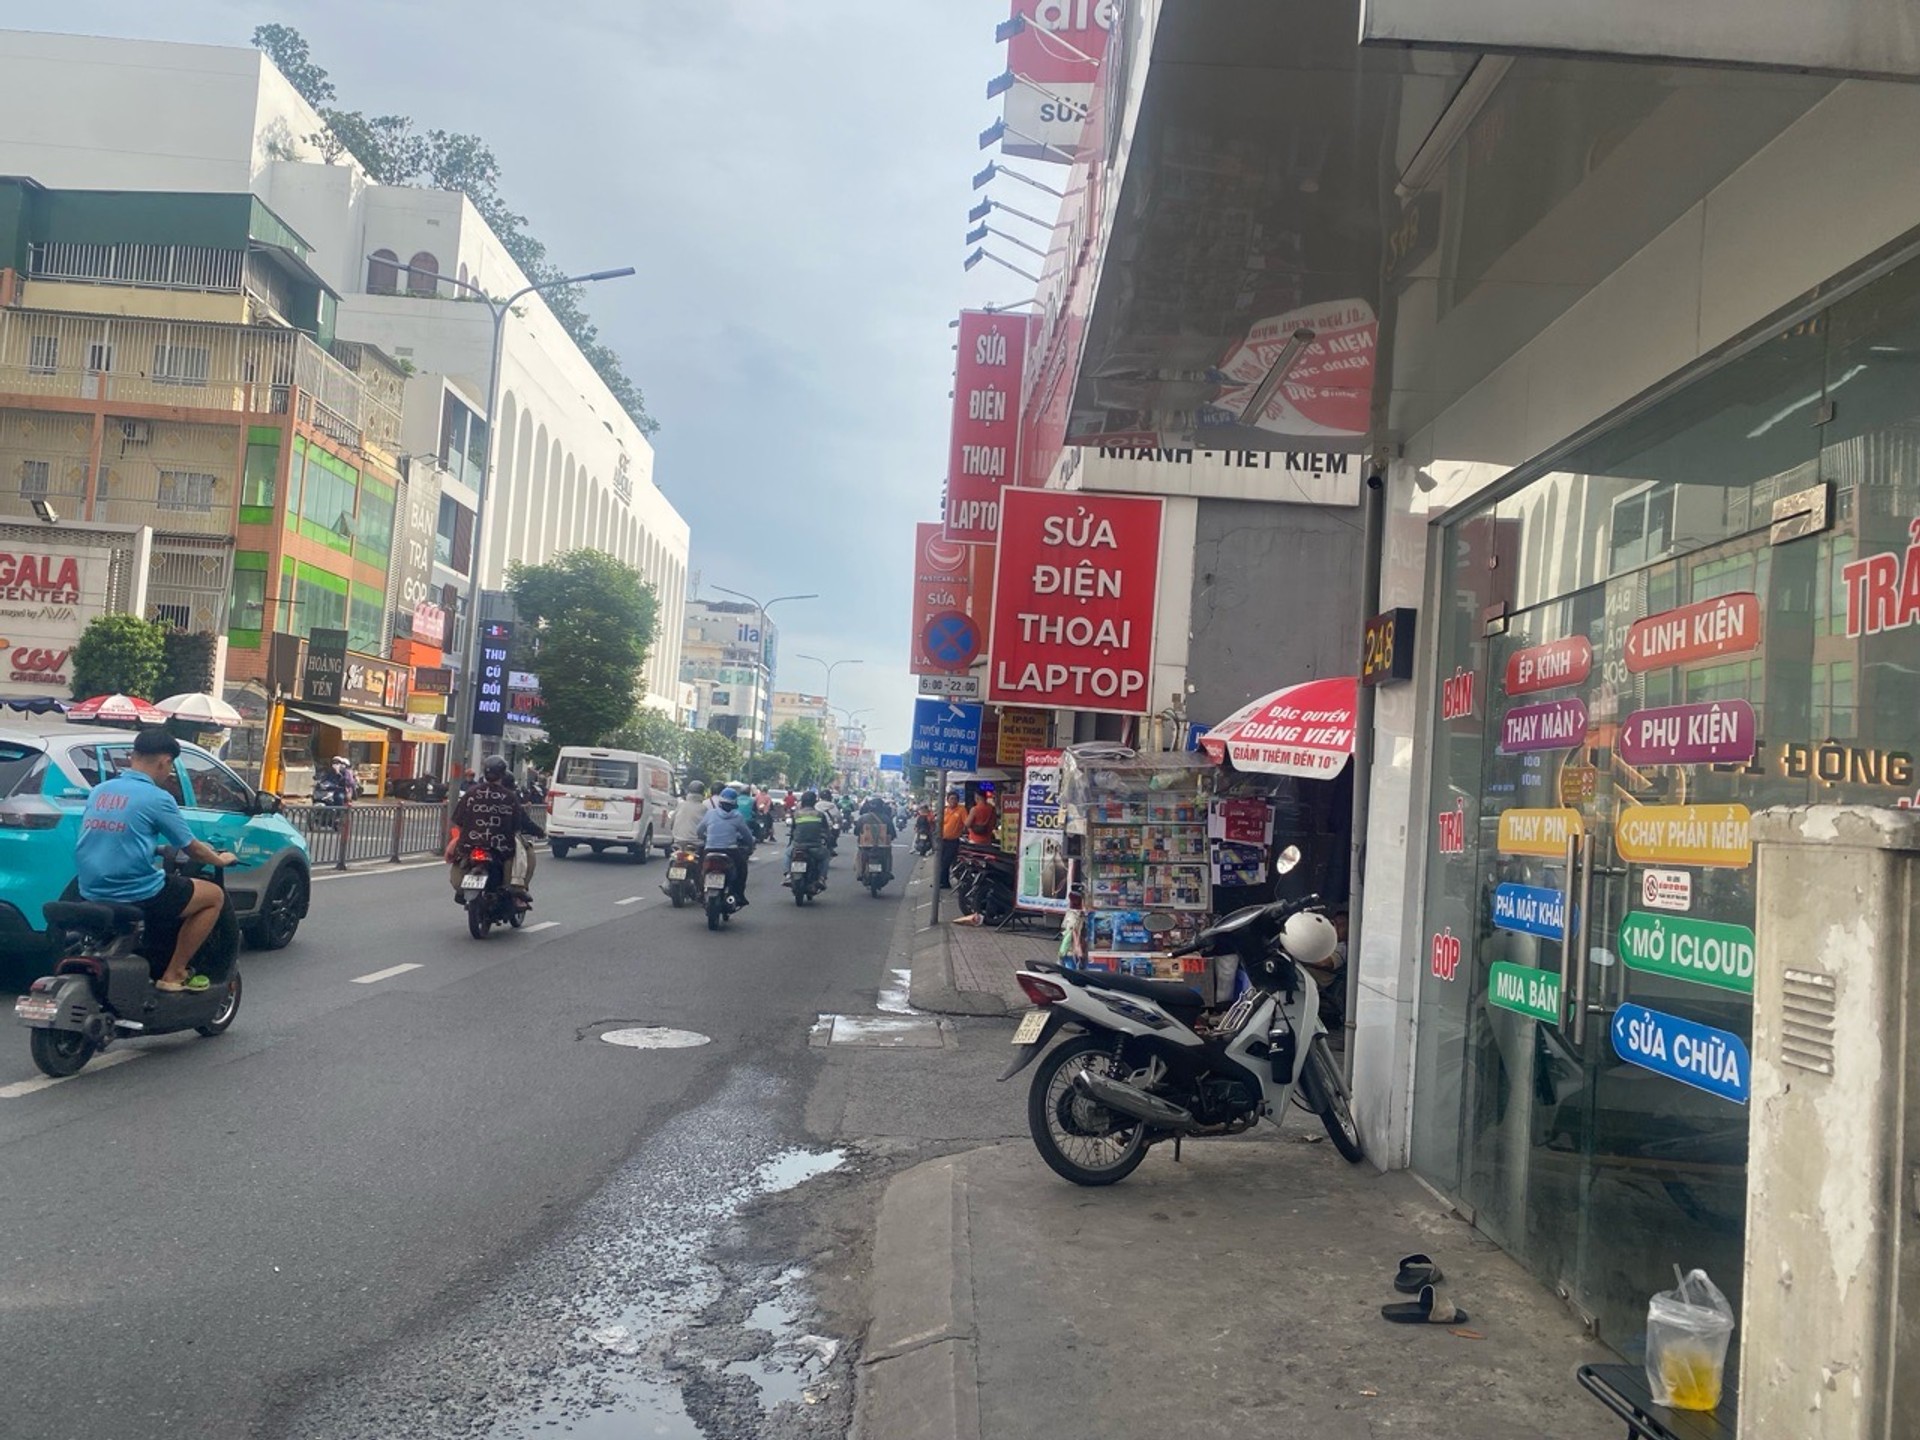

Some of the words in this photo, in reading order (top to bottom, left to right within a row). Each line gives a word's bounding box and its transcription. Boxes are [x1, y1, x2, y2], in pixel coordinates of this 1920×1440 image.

[976, 324, 1006, 366] SỬA
[969, 384, 1005, 427] ĐIỆN
[962, 444, 1005, 483] THOẠI
[950, 500, 998, 532] LAPTO
[1042, 506, 1118, 549] SỬA
[0, 586, 79, 605] ENTER
[927, 588, 957, 606] SỬA
[1032, 559, 1122, 604] ĐIỆN
[1842, 516, 1920, 638] TRẢ
[738, 623, 760, 643] ila
[1017, 613, 1132, 656] THOẠI
[1364, 620, 1394, 676] 248
[1643, 619, 1687, 657] LINH
[1694, 600, 1745, 650] KIỆN
[11, 647, 69, 673] CGV
[484, 648, 507, 661] THU
[1518, 654, 1534, 684] ÉP
[1537, 648, 1571, 680] KÍNH
[998, 660, 1144, 698] LAPTOP
[1442, 665, 1474, 721] BÁN
[1241, 719, 1302, 742] GIẢNG
[1303, 726, 1351, 746] VIÊN
[1268, 705, 1301, 721] ĐẶC
[1507, 714, 1538, 743] THAY
[1541, 703, 1574, 740] MÀN
[1641, 716, 1681, 756] PHỤ
[1688, 703, 1738, 754] KIỆN
[1233, 744, 1260, 761] GIẢM
[1262, 747, 1291, 764] THÊM
[1293, 749, 1316, 767] ĐẾN
[1781, 736, 1914, 788] ĐỘNG
[1438, 796, 1464, 853] TRẢ
[1509, 816, 1540, 842] THAY
[1544, 816, 1567, 842] PIN
[1629, 821, 1665, 854] CHẠY
[1496, 891, 1514, 917] PHÁ
[1517, 894, 1537, 928] MẬT
[1432, 926, 1460, 981] GÓP
[1633, 919, 1665, 961] MỞ
[1671, 932, 1754, 978] ICLOUD
[1497, 971, 1525, 1003] MUA
[1529, 974, 1558, 1013] BÁN
[1628, 1012, 1667, 1061] SỬA
[1674, 1034, 1741, 1087] CHỮA
